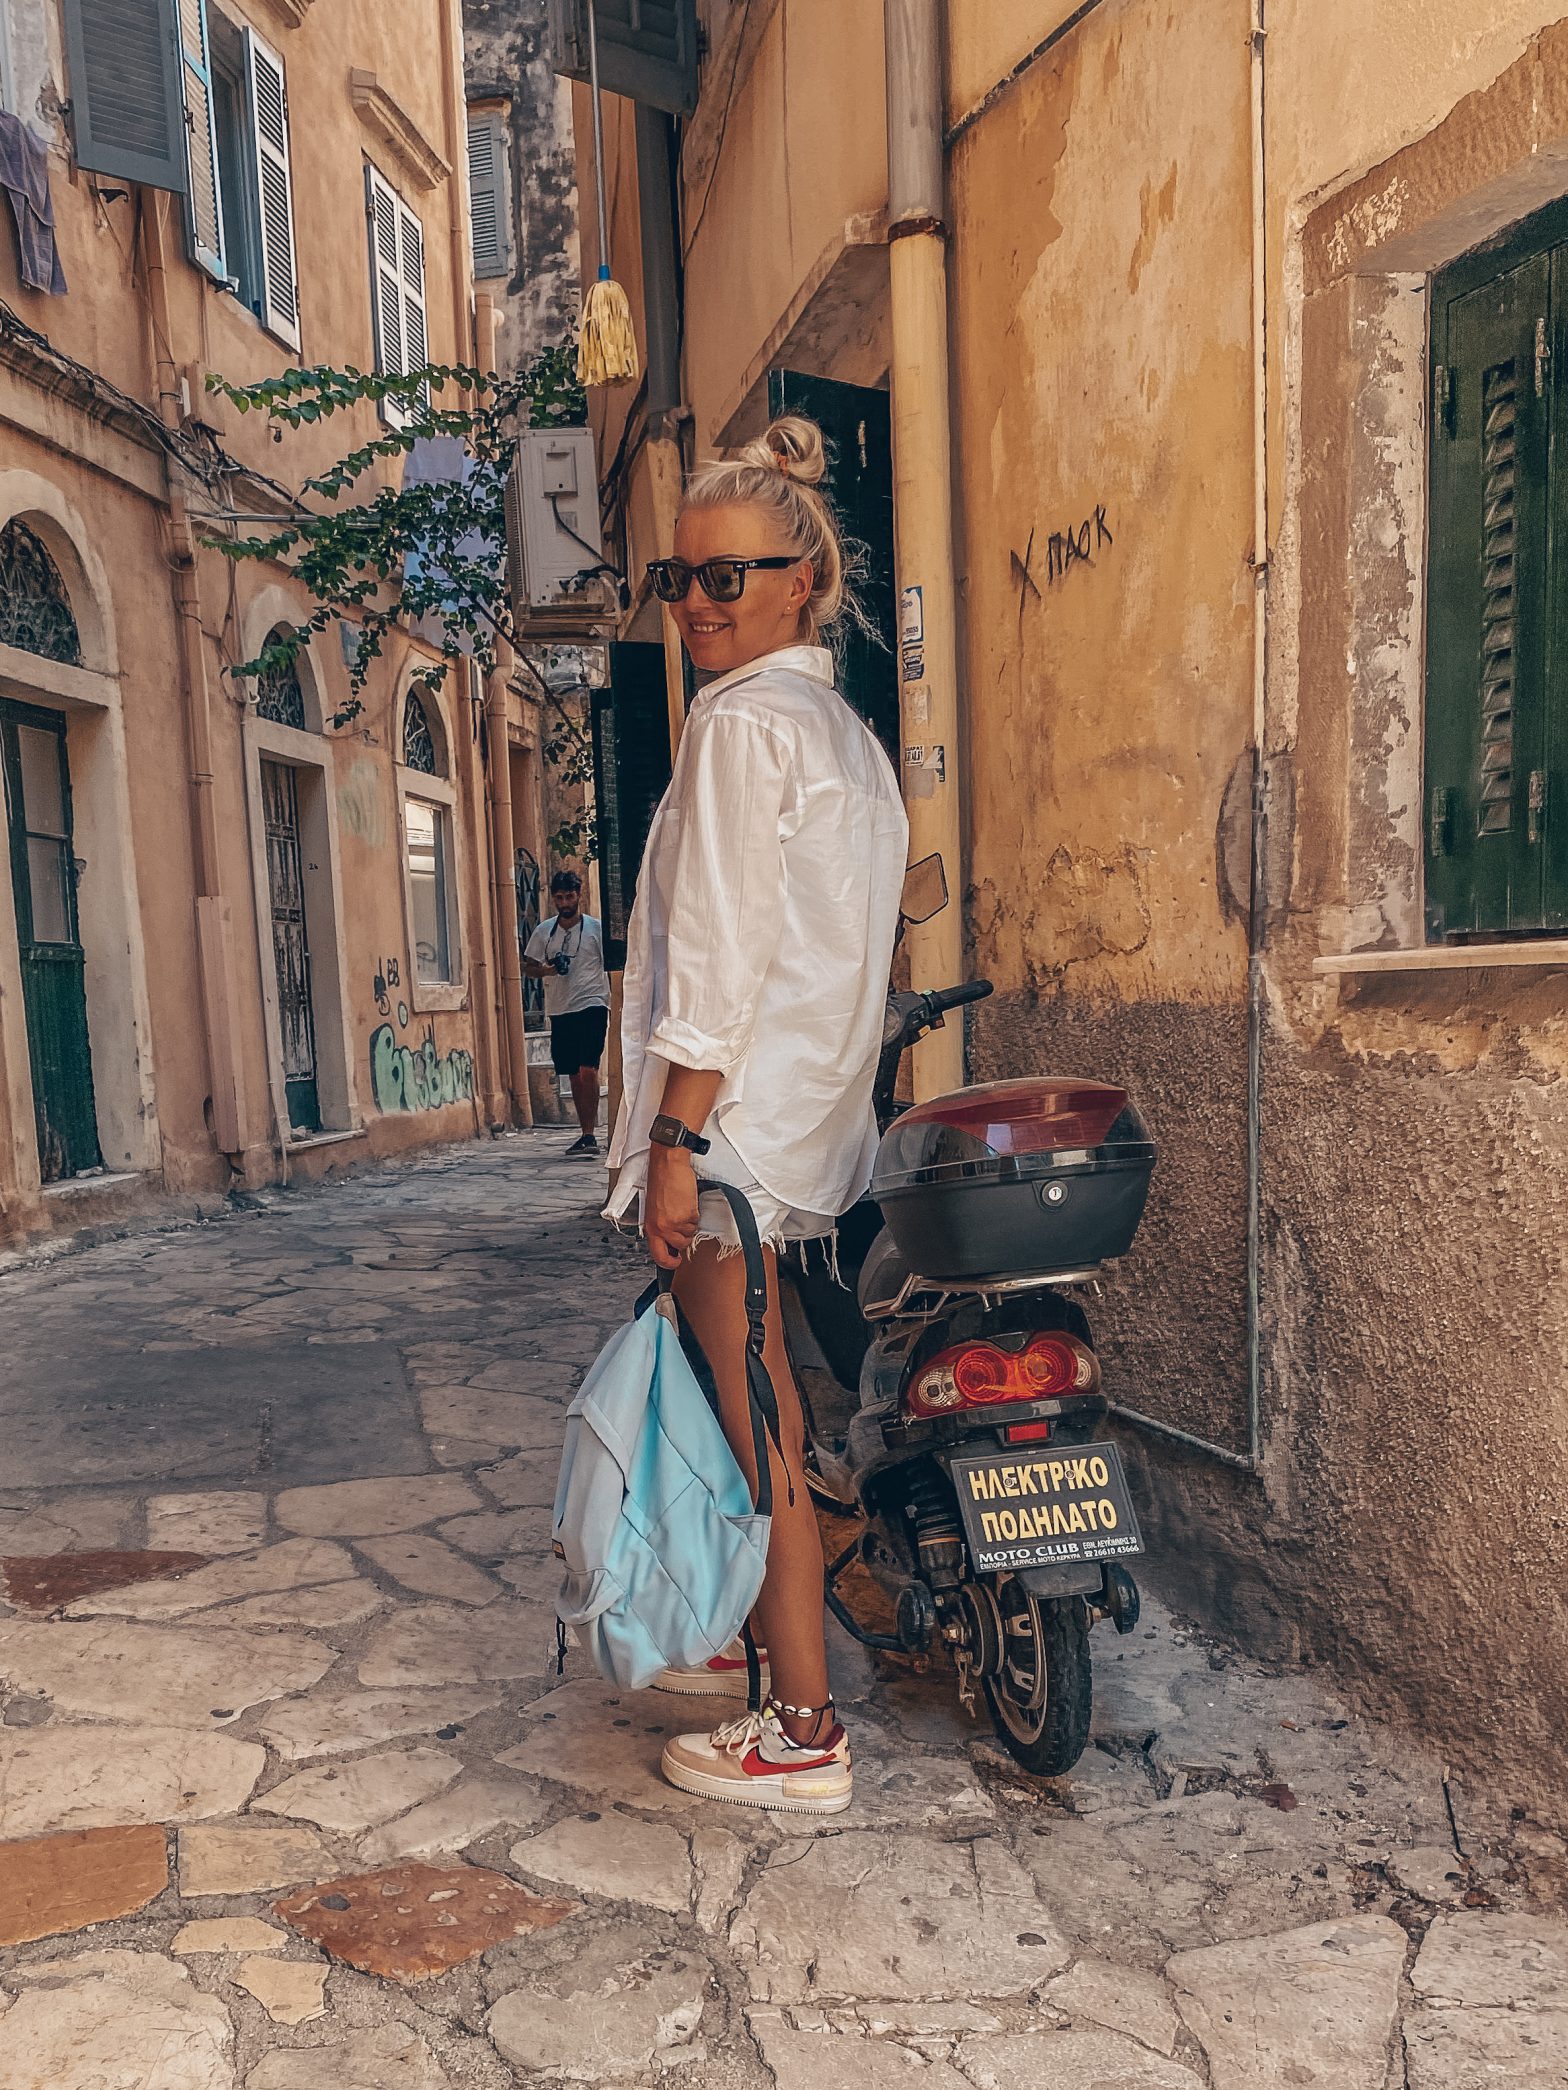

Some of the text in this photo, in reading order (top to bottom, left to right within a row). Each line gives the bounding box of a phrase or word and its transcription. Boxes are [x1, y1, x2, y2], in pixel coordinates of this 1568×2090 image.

[968, 1456, 1109, 1500] ΗΛΕΚΤΡΙΚΟ
[980, 1499, 1118, 1543] ΠΟΔΗΛΑΤΟ
[979, 1543, 1080, 1563] MOTO CLUB
[1093, 1544, 1140, 1557] 26610 43666
[1011, 1557, 1038, 1567] SERVICE
[1037, 1555, 1056, 1564] MOTO
